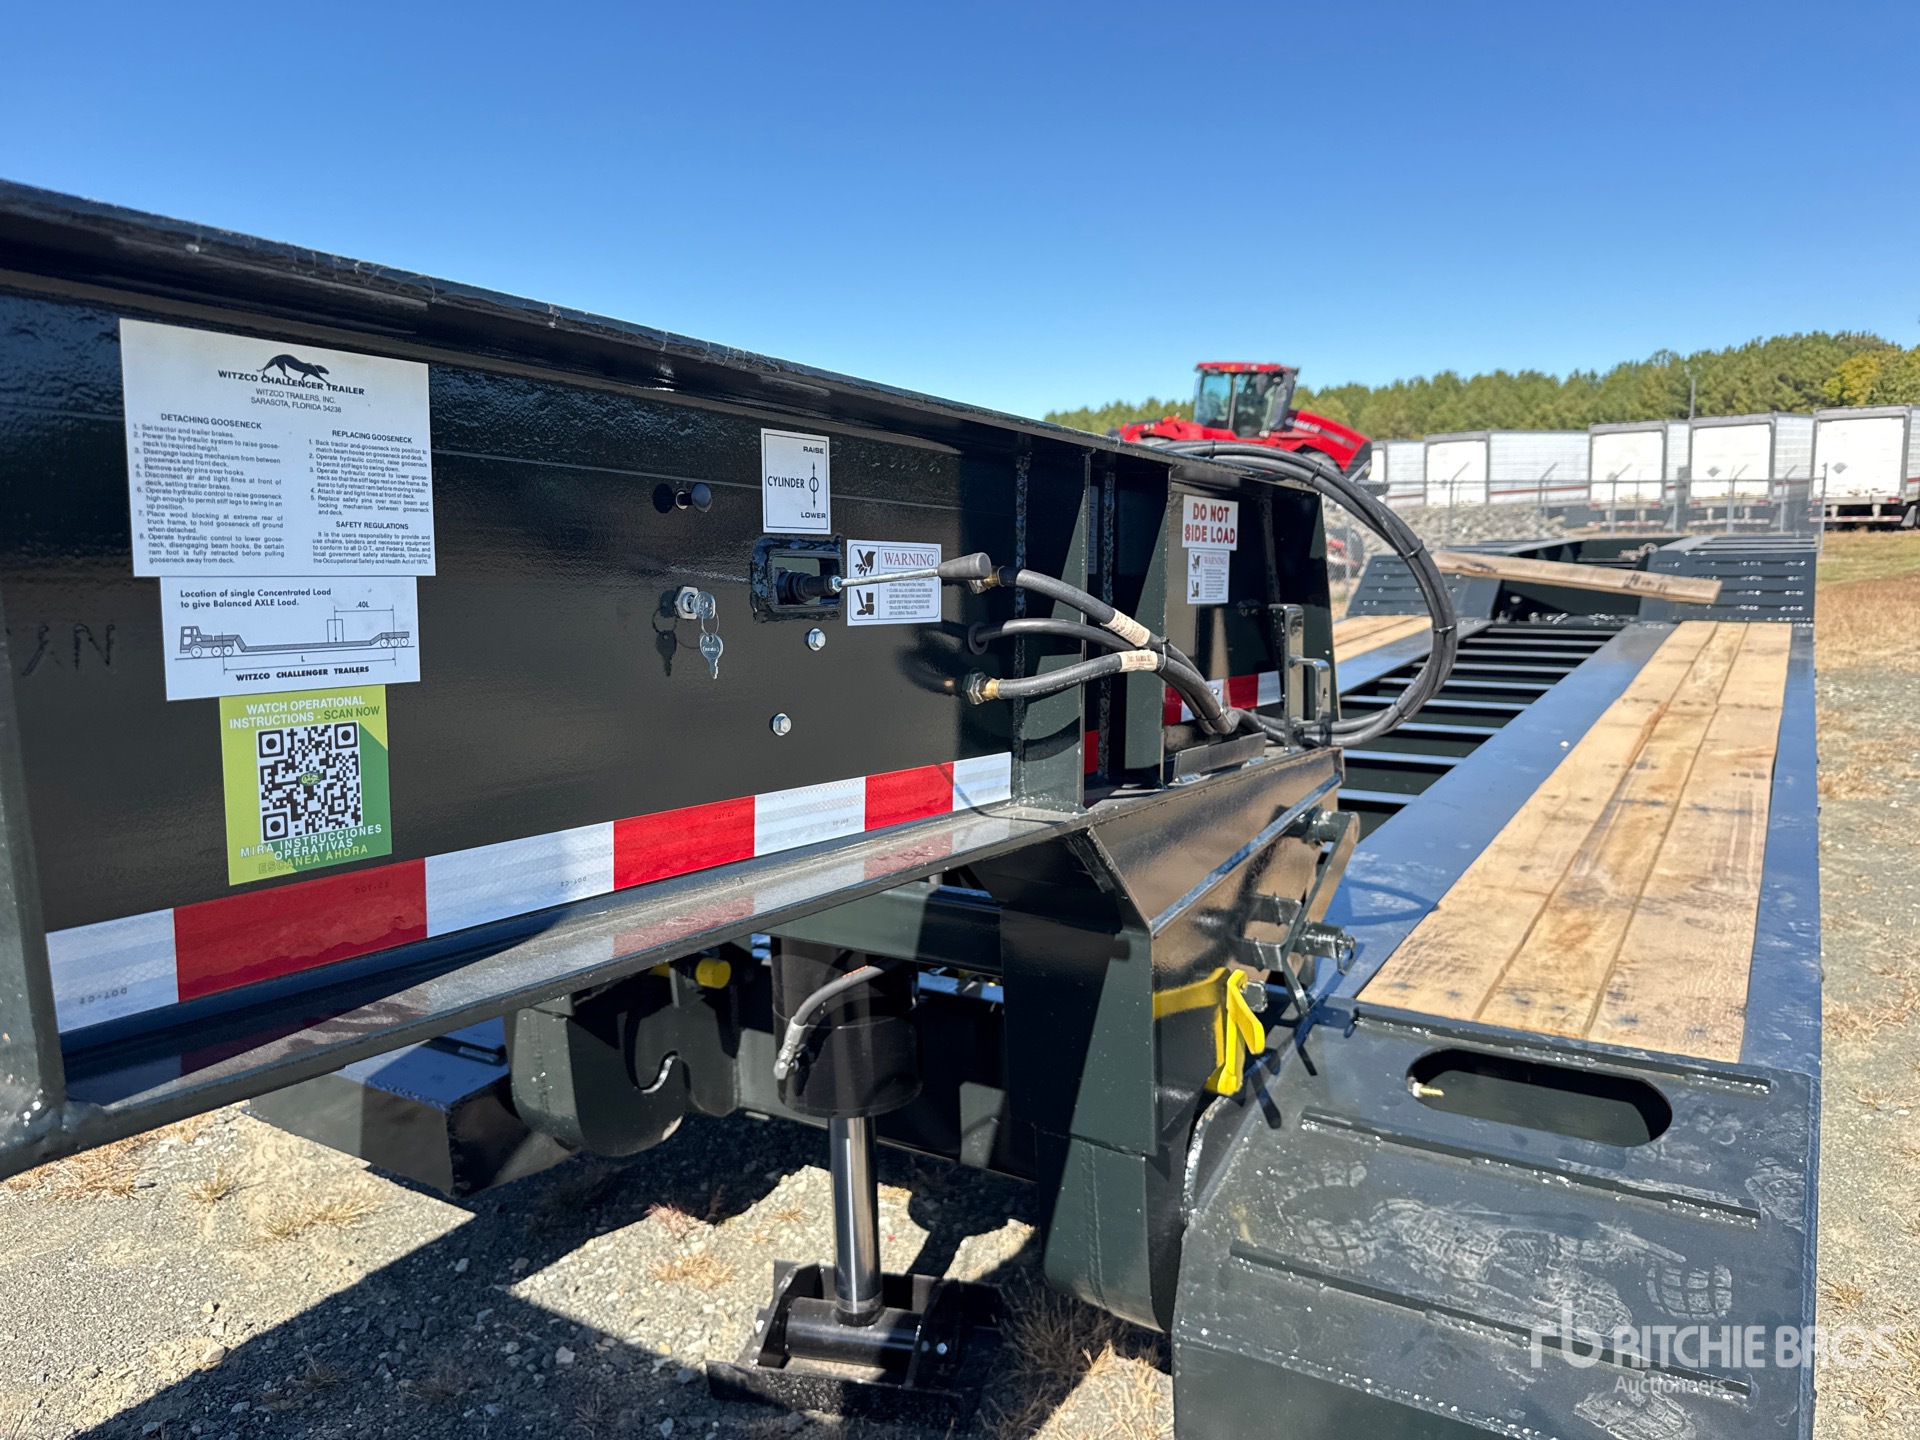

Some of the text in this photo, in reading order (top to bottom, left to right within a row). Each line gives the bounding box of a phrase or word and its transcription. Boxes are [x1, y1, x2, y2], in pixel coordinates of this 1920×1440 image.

[218, 369, 364, 395] WITZCO CHALLENGER TRAILER
[255, 388, 336, 403] WITZCO TRAILERS, INC.
[250, 396, 341, 413] SARASOTA, FLORIDA 34238
[160, 413, 261, 429] DETACHING GOOSENECK
[331, 430, 411, 443] REPLACING GOOSENECK
[803, 446, 824, 454] RAISE
[768, 476, 804, 489] CYLINDER
[1193, 503, 1230, 523] DO NOT
[1184, 524, 1236, 544] SIDE LOAD
[884, 552, 934, 566] WARNING
[180, 588, 332, 598] Location of single Concentrated Load
[180, 598, 300, 610] to give Balanced AXLE Load.
[236, 666, 370, 682] WITZCO CHALLENGER TRAILERS
[246, 696, 365, 714] WATCH OPERATIONAL
[230, 712, 314, 729] INSTRUCTIONS
[324, 707, 354, 720] SCAN
[356, 706, 380, 718] NOW
[240, 824, 382, 858] MIRA INSTRUCCIONES
[274, 838, 354, 860] OPERATIVAS
[258, 844, 368, 874] ESCANEA AHORA
